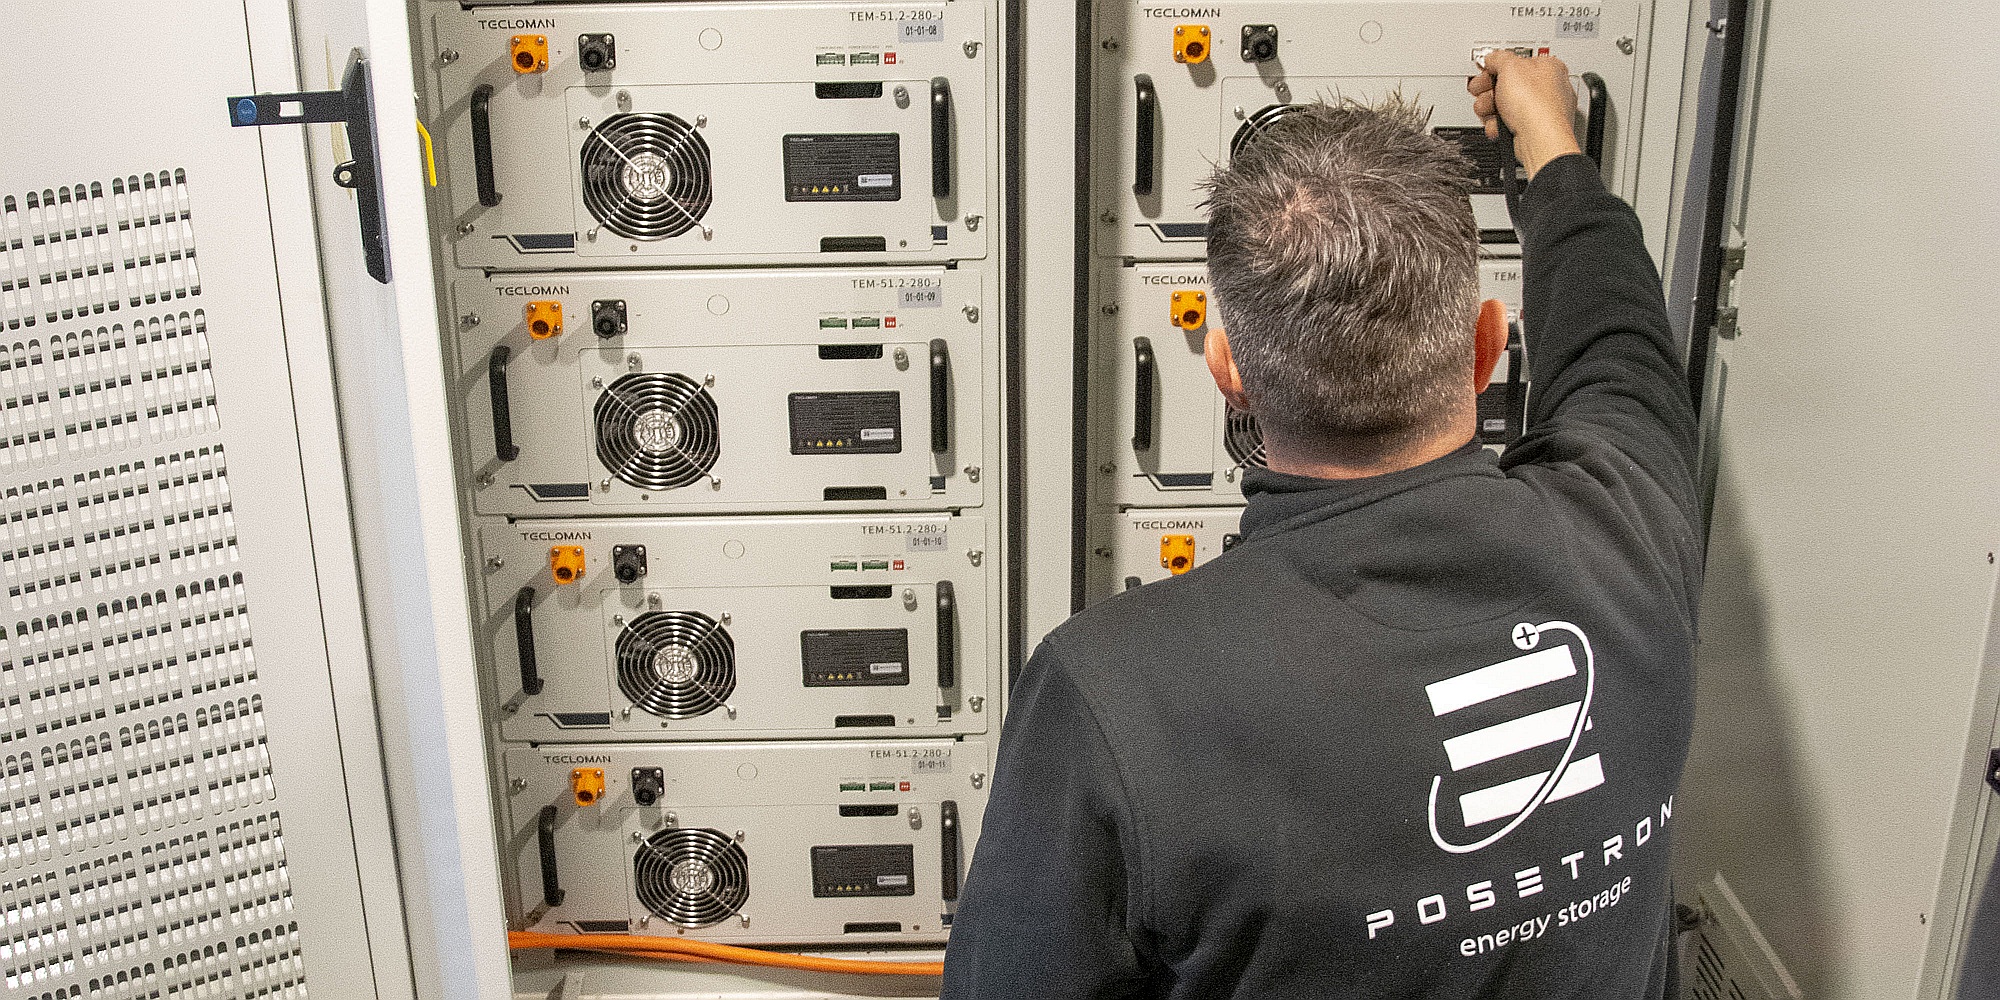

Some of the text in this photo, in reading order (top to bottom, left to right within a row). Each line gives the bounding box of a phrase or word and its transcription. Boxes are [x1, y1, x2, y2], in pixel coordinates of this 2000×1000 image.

[849, 10, 944, 23] TEM-51.2-280-J
[1143, 8, 1221, 19] TECLOMAN
[1510, 6, 1601, 18] TEM-51.2-280-J
[478, 19, 556, 30] TECLOMAN
[905, 24, 937, 37] 01-01-08
[852, 278, 942, 290] TEM-51.2-280-J
[495, 286, 570, 296] TECLOMAN
[861, 524, 947, 535] TEM-51.2-280-J
[1133, 520, 1204, 530] TECLOMAN
[520, 531, 592, 541] TECLOMAN
[870, 748, 952, 759] TEM-51.2-280-J
[543, 755, 612, 765] TECLOMAN
[1366, 795, 1673, 940] POSETRON
[1460, 875, 1632, 957] energy storage
